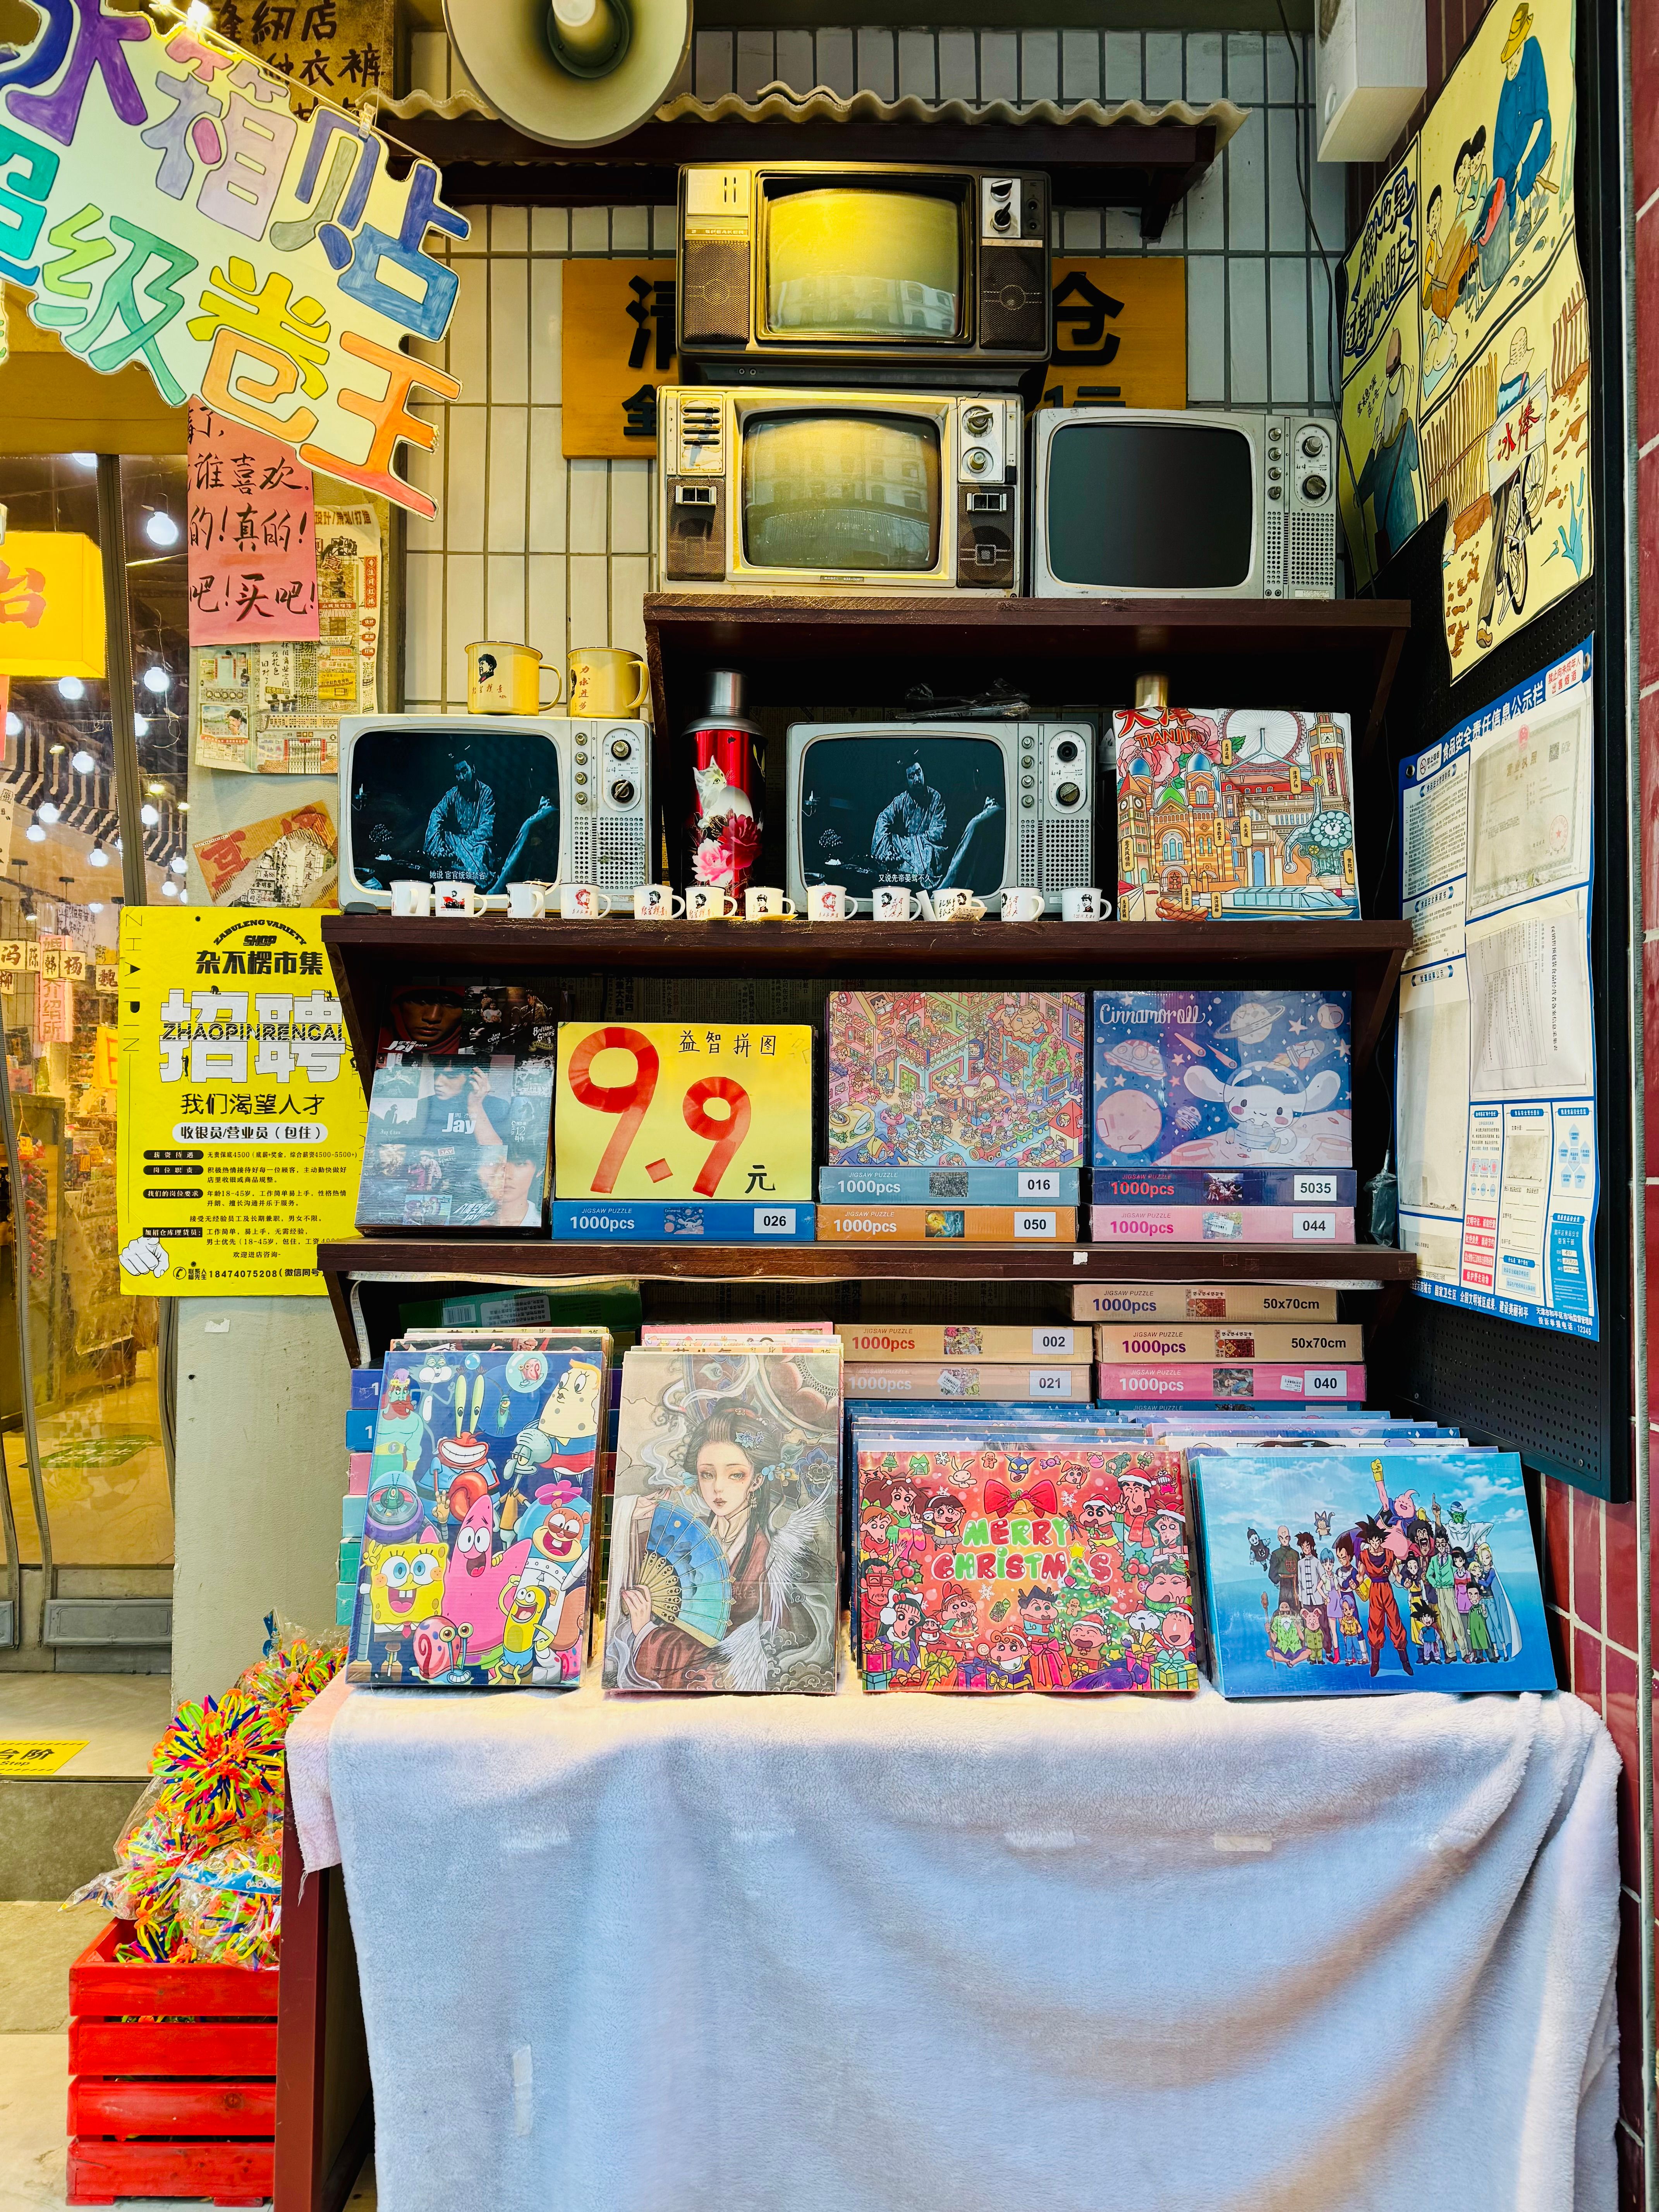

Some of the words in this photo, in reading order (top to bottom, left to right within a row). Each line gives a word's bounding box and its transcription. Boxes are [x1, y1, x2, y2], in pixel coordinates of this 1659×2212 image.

[1497, 396, 1541, 462] 冰棒
[187, 452, 309, 496] 谁喜欢。
[1548, 655, 1581, 685] 禁止向未成年人
[1443, 680, 1544, 763] 食品安全责任信息公示栏
[1135, 728, 1198, 750] TIANJIN
[429, 870, 443, 879] 她说
[878, 873, 930, 883] 又说先帝晏驾不久
[213, 919, 266, 946] ZABULENG
[266, 920, 307, 946] VARIETY
[243, 934, 278, 946] SHOP
[42, 937, 62, 1042] 婚介绍所
[1100, 1003, 1206, 1025] Cinnamoroll
[159, 988, 346, 1084] 招聘
[162, 1023, 343, 1042] ZHAOPINRENCAI
[678, 1029, 776, 1058] 益智拼图
[181, 1093, 325, 1115] 我们渴望人才
[568, 1027, 751, 1198] 9.9
[441, 1112, 477, 1135] Jay
[515, 1126, 526, 1136] 12
[744, 1164, 776, 1194] 元
[1027, 1179, 1051, 1190] 016
[837, 1180, 901, 1196] 1000pcs
[1110, 1182, 1175, 1198] 1000pcs
[1300, 1182, 1331, 1194] 5035
[570, 1216, 635, 1232] 1000pcs
[763, 1215, 787, 1227] 026
[833, 1219, 897, 1236] 1000pcs
[1023, 1219, 1046, 1231] 050
[1110, 1220, 1174, 1237] 1000pcs
[1302, 1220, 1326, 1232] 044
[1434, 1286, 1457, 1301] 国家卫生区
[1092, 1298, 1157, 1314] 1000pcs
[1263, 1298, 1320, 1310] 50x70cm
[852, 1336, 915, 1352] 1000pcs
[1042, 1336, 1066, 1347] 002
[1121, 1340, 1187, 1356] 1000pcs
[1291, 1337, 1346, 1349] 50x70cm
[848, 1376, 912, 1393] 1000pcs
[1039, 1377, 1061, 1389] 021
[1119, 1377, 1184, 1393] 1000pcs
[1314, 1378, 1337, 1389] 040
[962, 1516, 1070, 1548] MERRY
